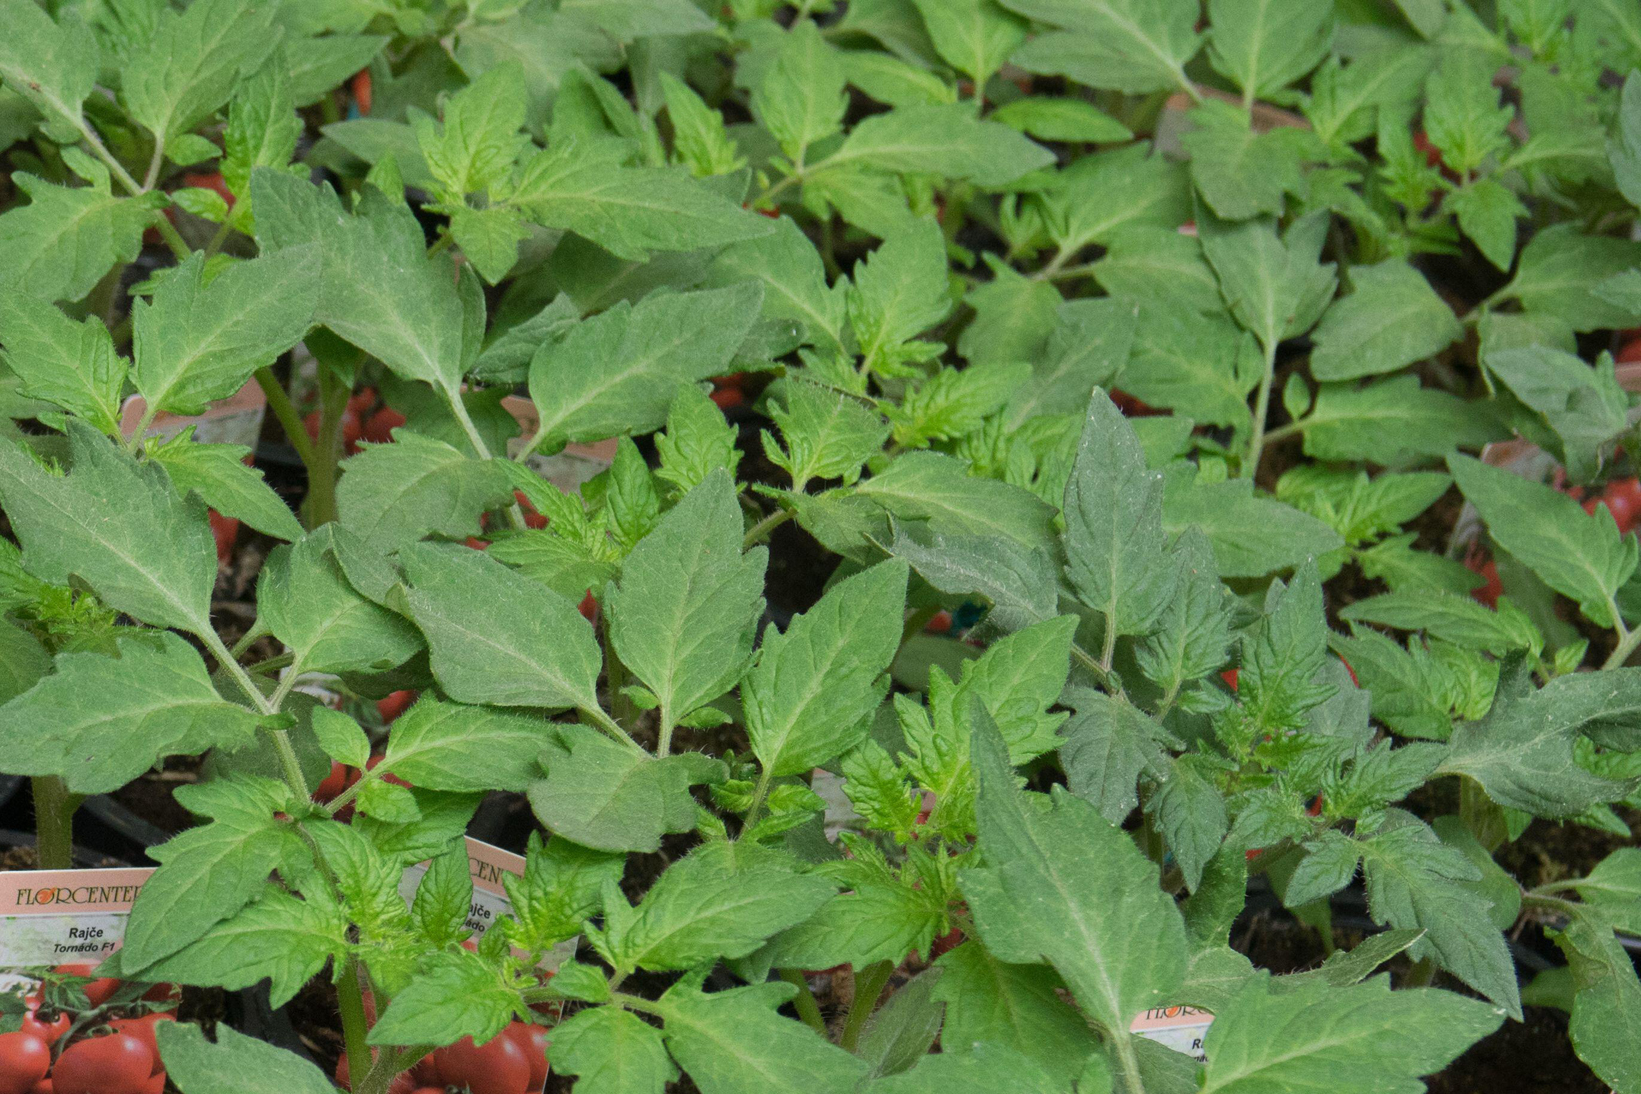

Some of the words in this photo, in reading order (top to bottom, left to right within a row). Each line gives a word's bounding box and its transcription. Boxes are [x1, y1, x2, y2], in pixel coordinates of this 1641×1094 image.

[469, 902, 491, 919] ajče
[69, 926, 104, 941] Rajče
[54, 943, 98, 953] Tornádo
[101, 942, 116, 952] F1
